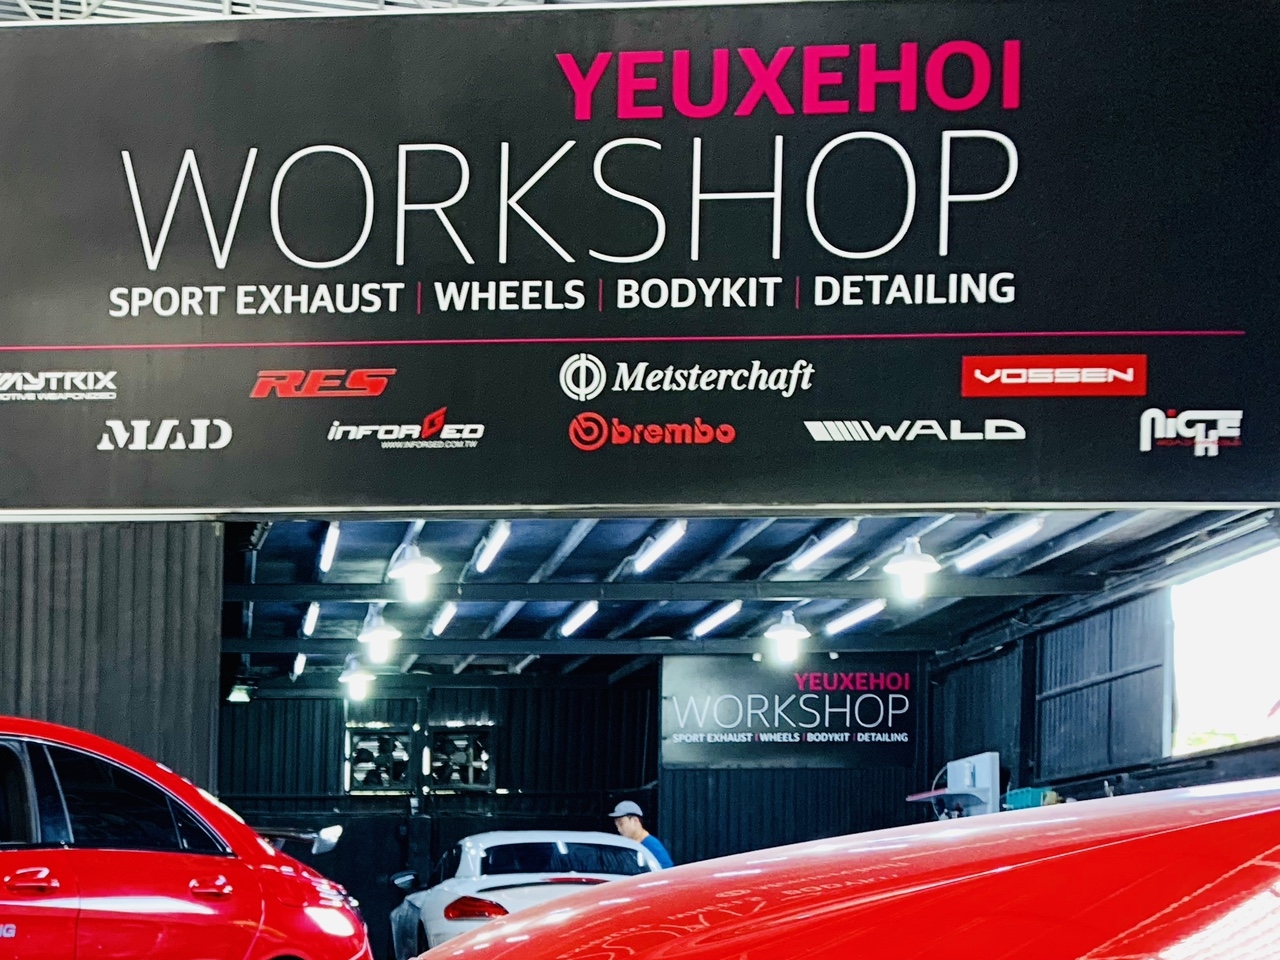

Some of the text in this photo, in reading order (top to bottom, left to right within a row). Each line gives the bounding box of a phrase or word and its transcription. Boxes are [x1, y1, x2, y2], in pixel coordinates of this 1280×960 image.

[557, 40, 1020, 120] YEUXEHOI
[121, 130, 1018, 271] WORKSHOP
[108, 272, 1015, 317] SPORT EXHAUST WHEELS BODYKIT DETAILING
[249, 368, 397, 398] RES
[611, 360, 815, 398] Meisterchaft
[974, 368, 1134, 384] VOSSEN
[97, 419, 233, 450] MAD
[612, 417, 736, 444] brembo
[862, 419, 1027, 441] WALD
[794, 672, 910, 691] YEUXEHOI
[673, 694, 910, 728] WORKSHOP
[672, 732, 908, 743] SPORT EXHAUST WHEELS BODYKIT DETAILING
